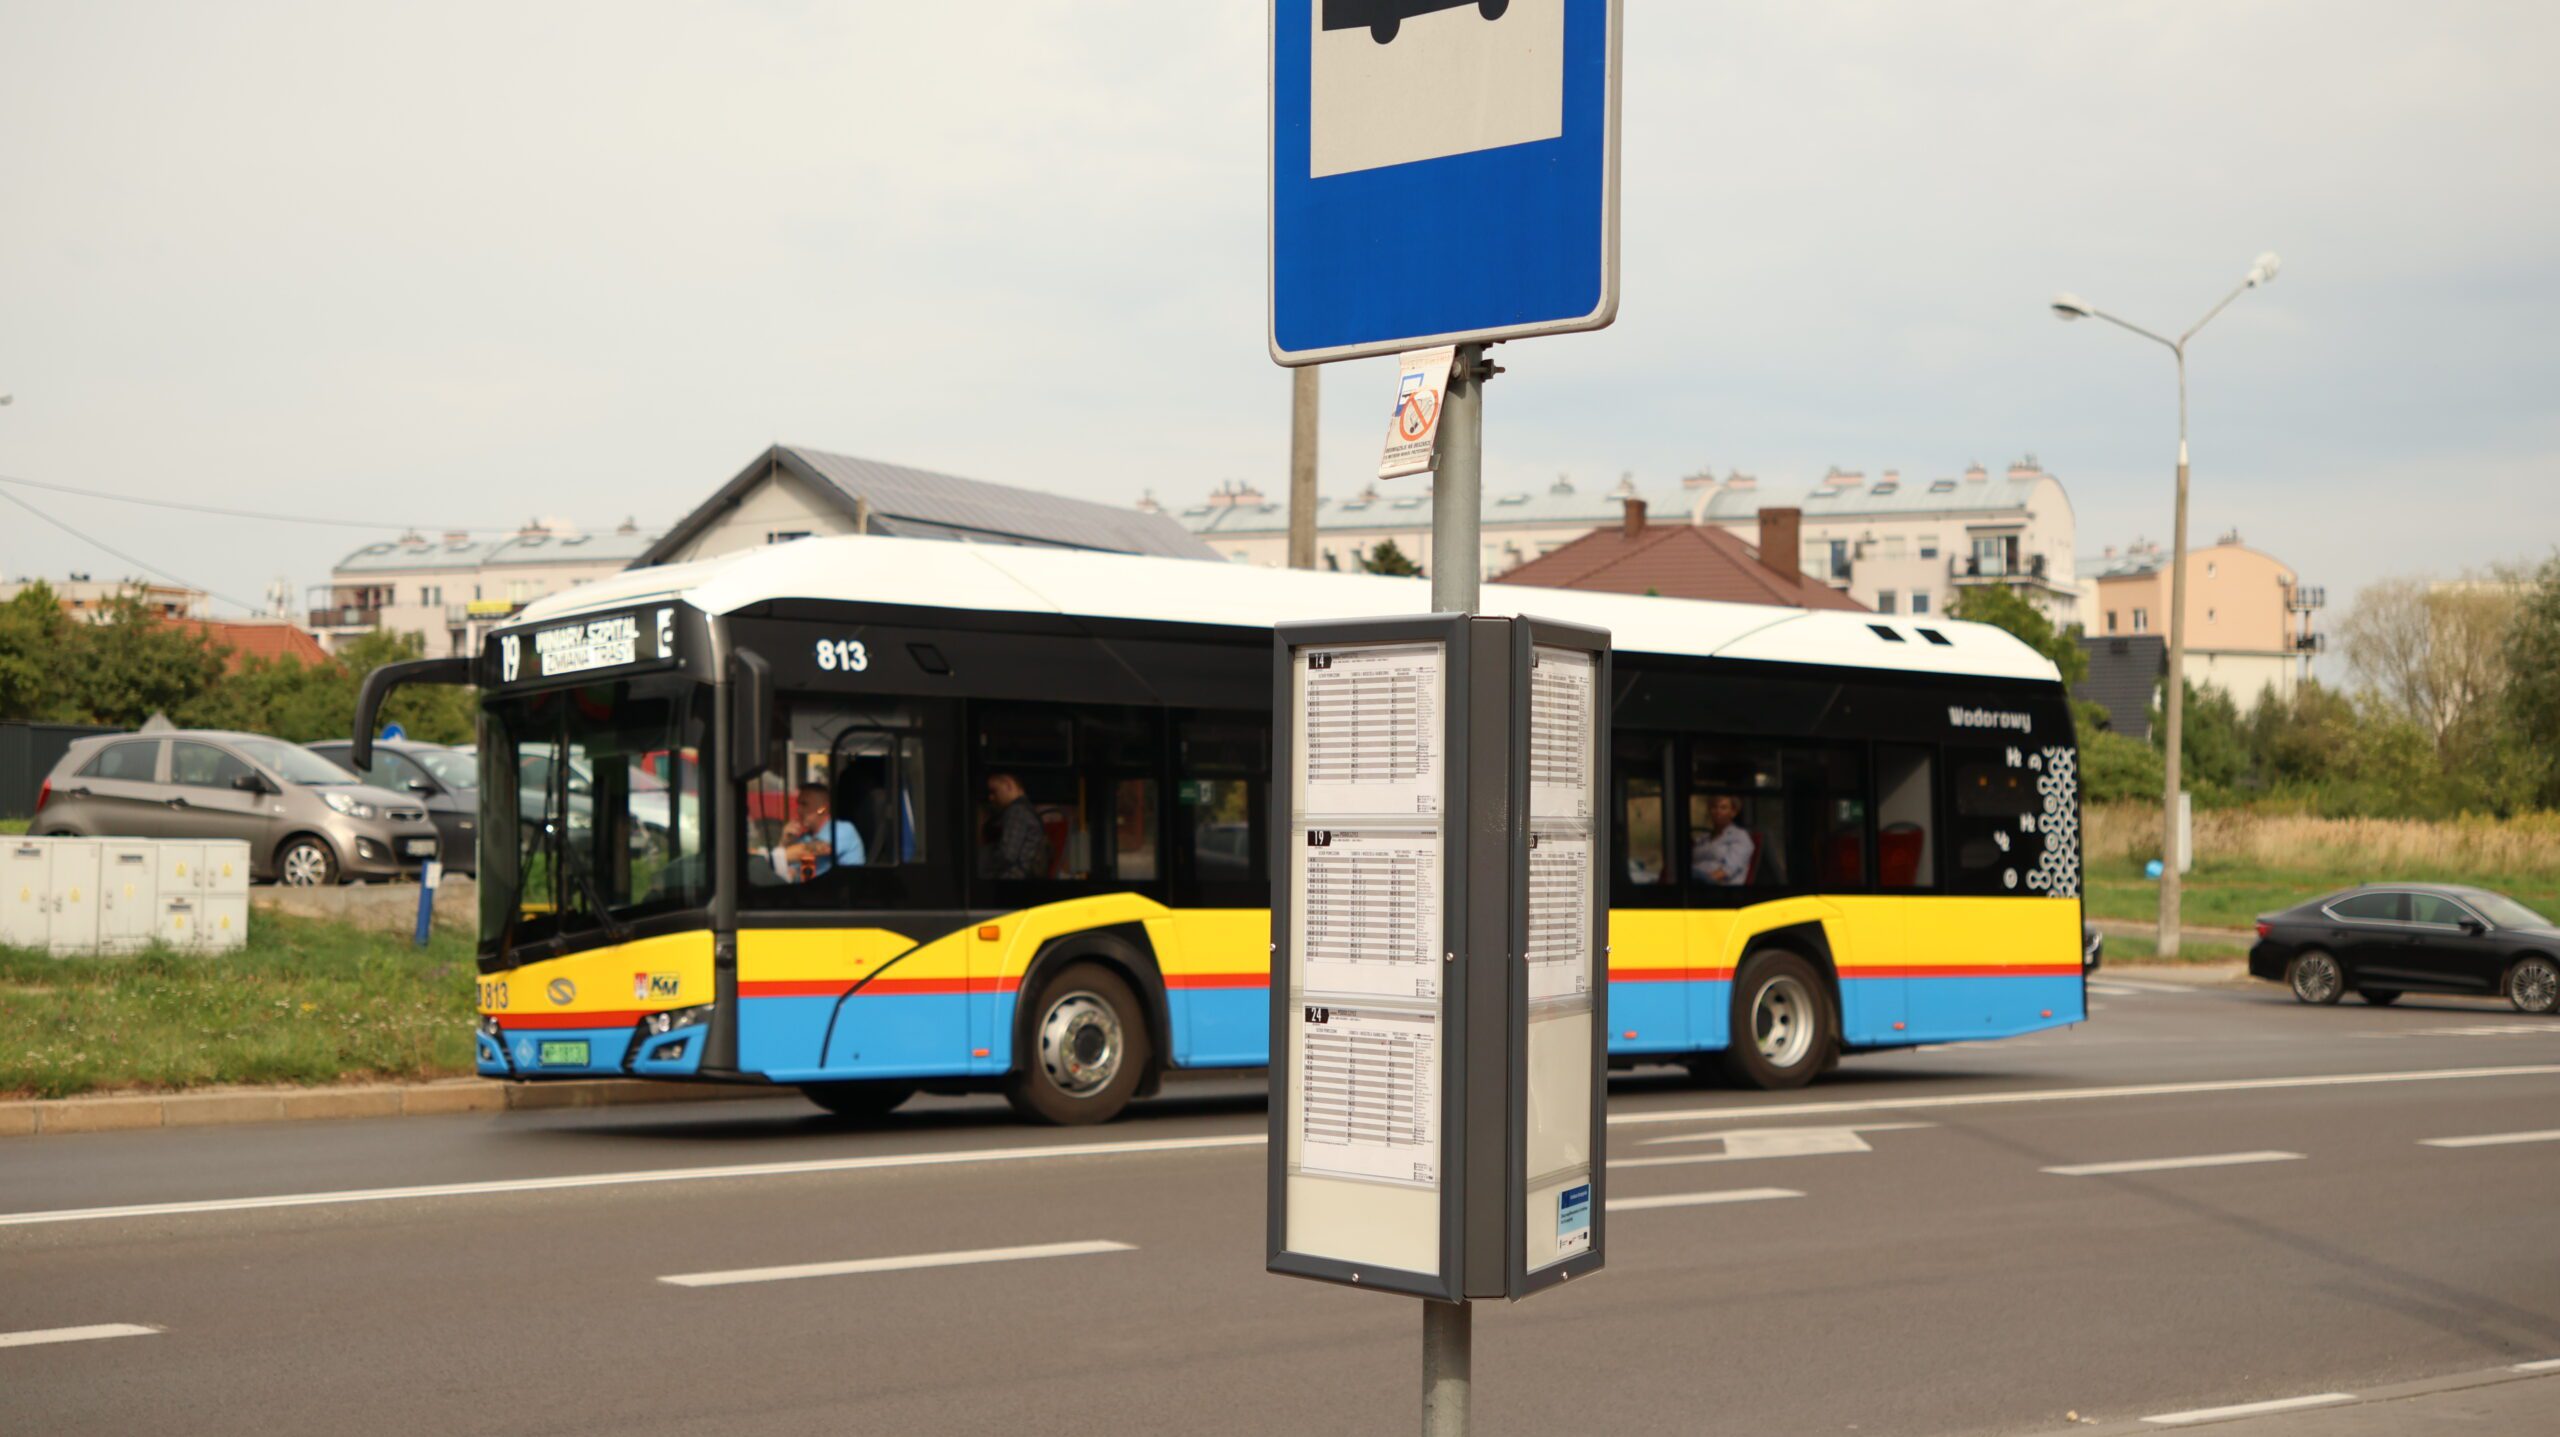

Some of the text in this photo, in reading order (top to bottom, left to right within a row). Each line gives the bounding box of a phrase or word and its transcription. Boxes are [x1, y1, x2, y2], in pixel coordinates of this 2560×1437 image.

[501, 634, 521, 682] 19
[815, 638, 869, 673] 813
[1314, 653, 1324, 669] 14
[1947, 706, 2032, 734] Wodorowy
[1314, 831, 1325, 846] 19
[485, 982, 509, 1009] 813
[1311, 1007, 1322, 1023] 24
